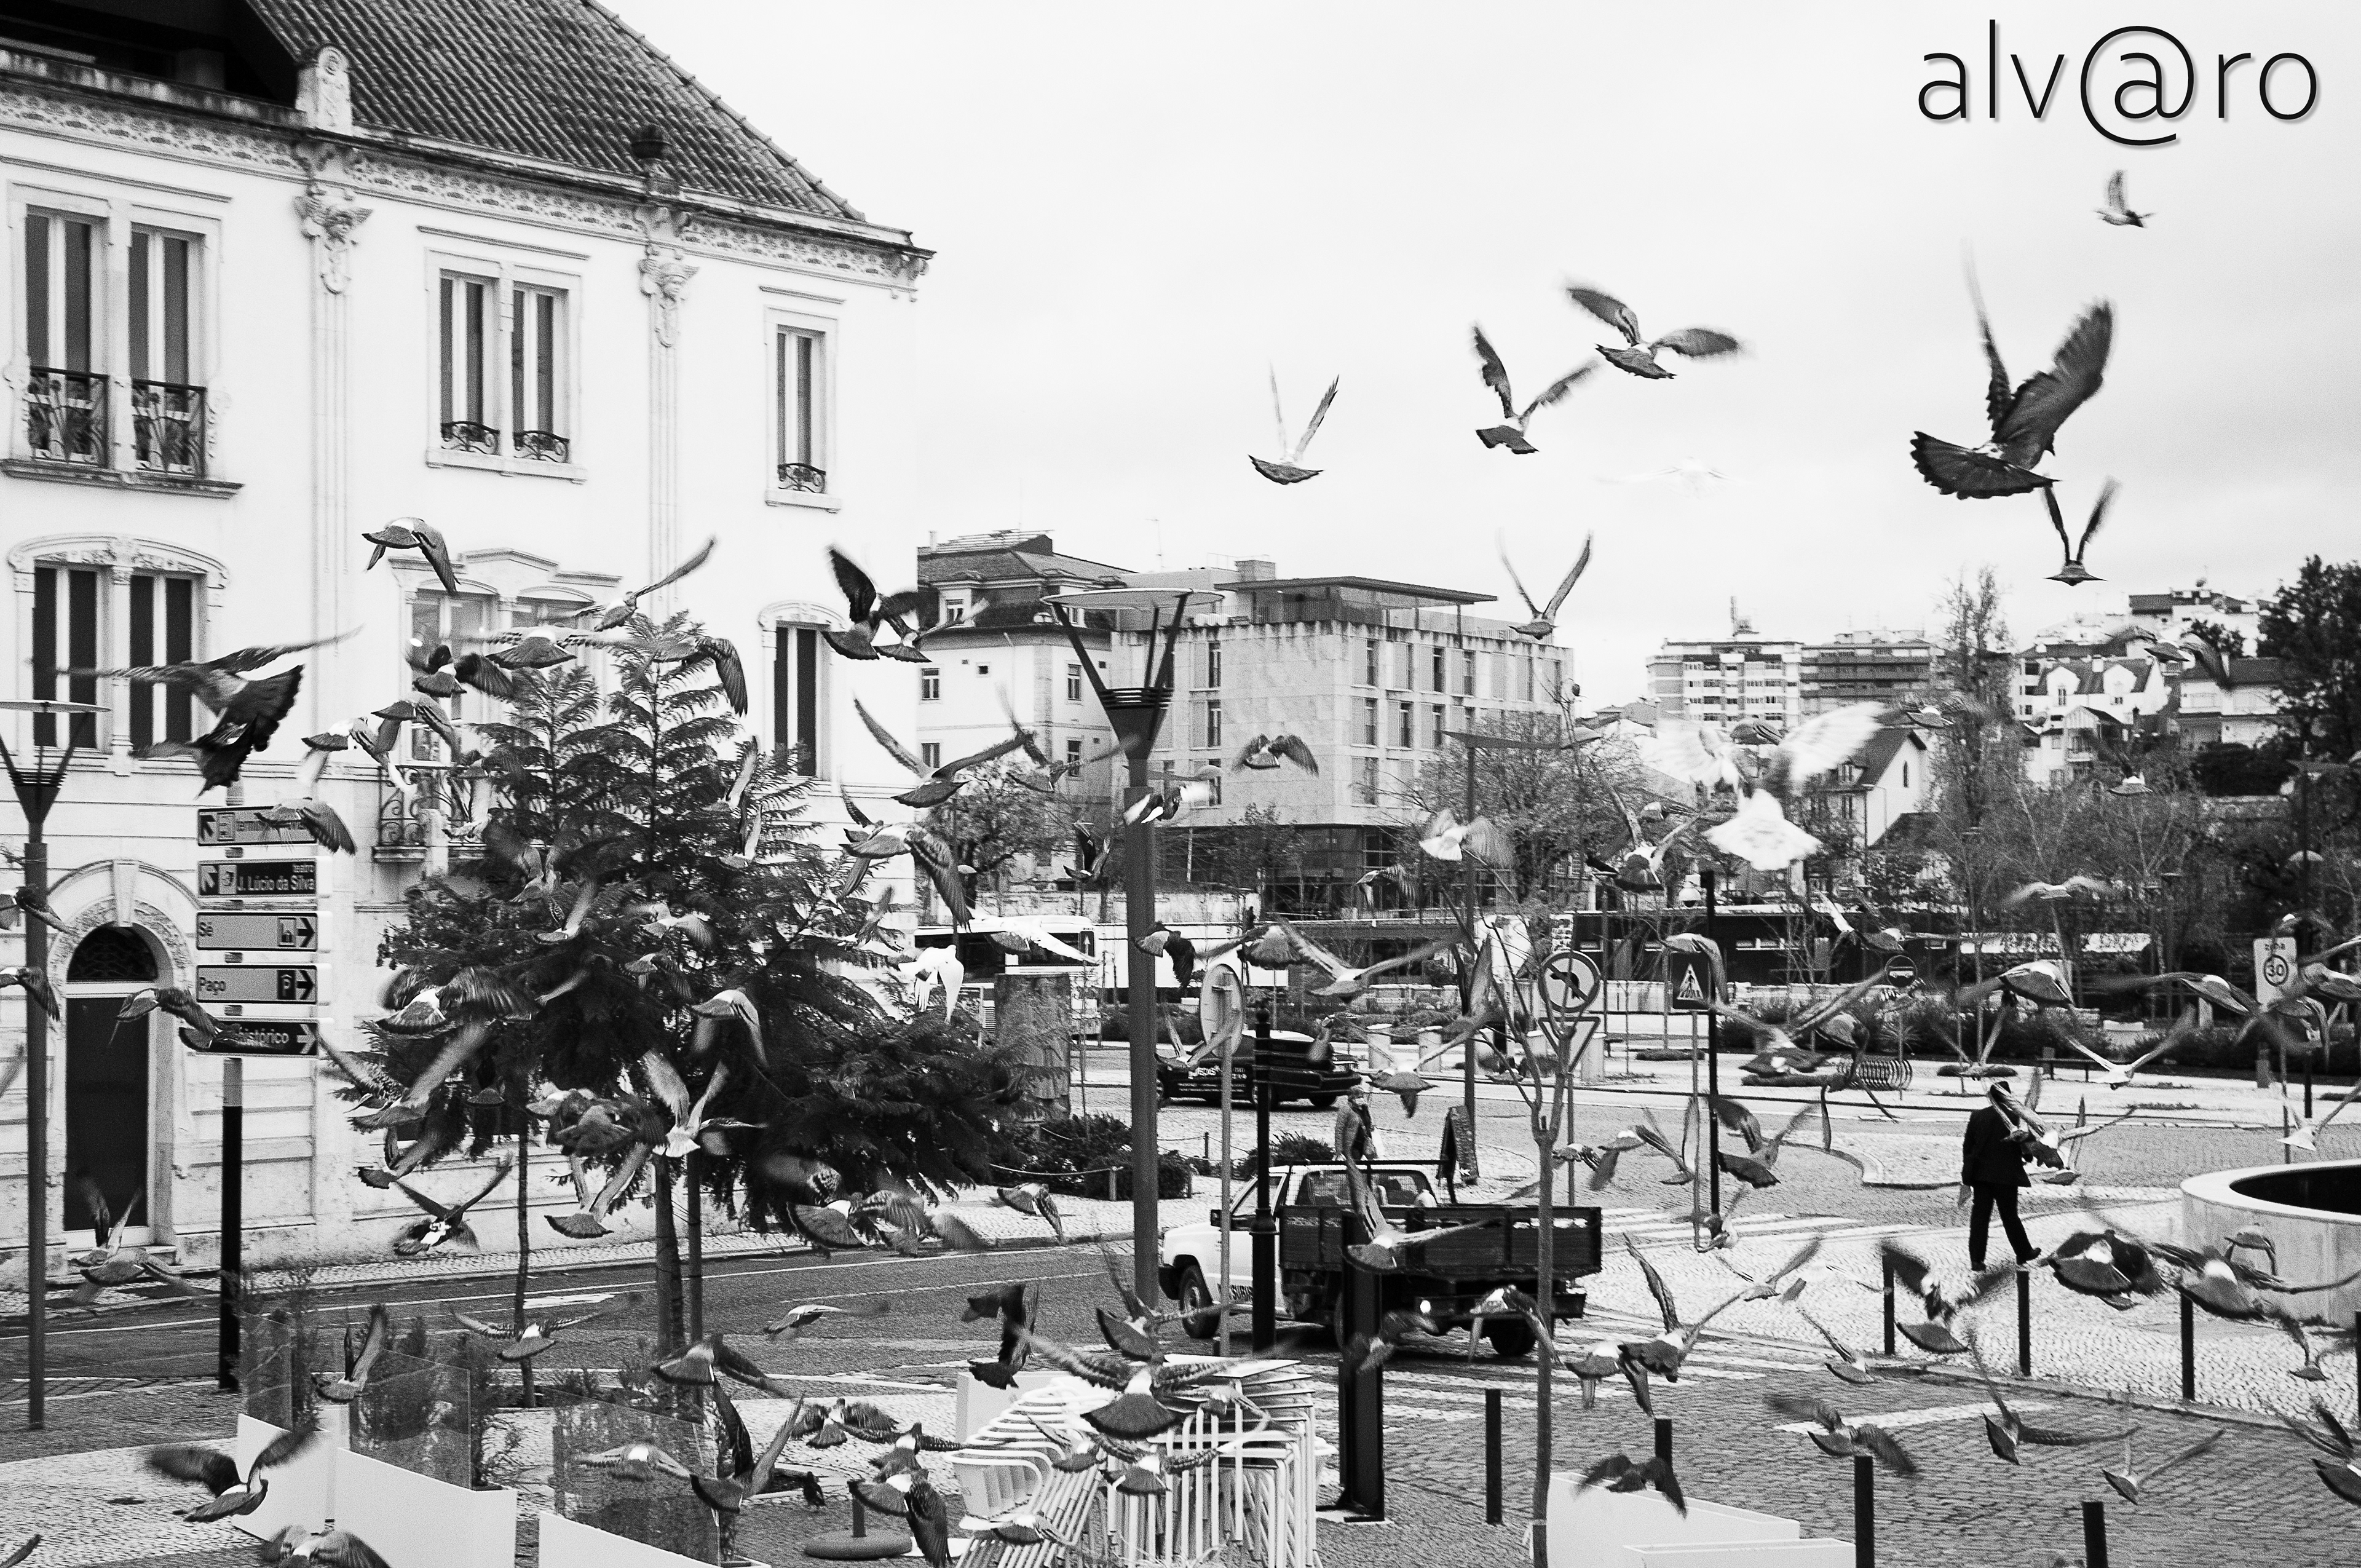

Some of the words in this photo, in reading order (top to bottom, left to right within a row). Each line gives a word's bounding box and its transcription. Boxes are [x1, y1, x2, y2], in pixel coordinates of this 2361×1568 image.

[247, 874, 275, 892] Lúcio
[276, 875, 290, 891] da
[290, 874, 315, 891] Silva
[199, 921, 213, 937] Sé
[2267, 963, 2285, 978] 30
[199, 976, 227, 996] Paço
